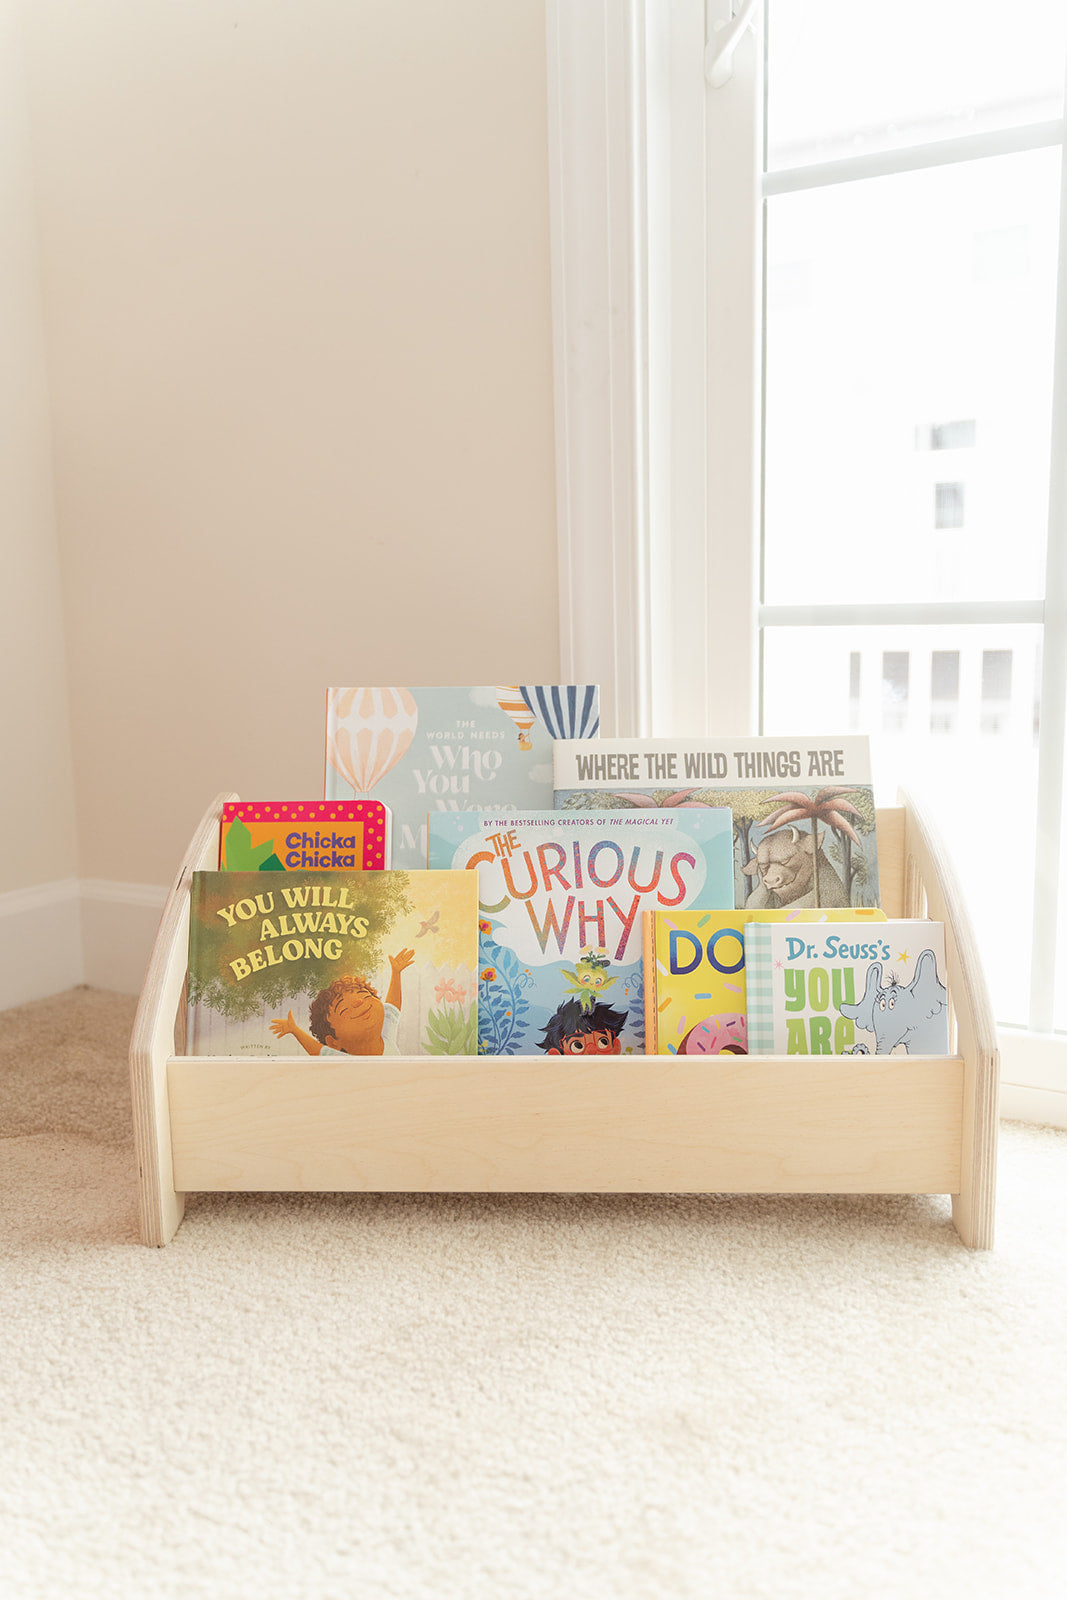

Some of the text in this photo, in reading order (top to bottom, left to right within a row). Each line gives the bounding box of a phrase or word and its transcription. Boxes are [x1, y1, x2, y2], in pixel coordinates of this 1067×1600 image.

[425, 731, 505, 740] WORLD NEEDS
[455, 719, 477, 729] THE
[428, 744, 503, 781] Who
[575, 750, 845, 781] WHERE THE WILD THINGS ARE
[412, 768, 470, 795] You
[495, 819, 507, 827] THE
[510, 818, 555, 827] BESTSELLING
[557, 818, 594, 826] CREATORS
[596, 818, 607, 826] OF
[609, 818, 623, 826] THE
[625, 818, 659, 826] MAGICAL
[661, 818, 674, 826] YET
[285, 831, 356, 849] Chicka
[485, 829, 521, 858] THE
[285, 850, 355, 868] Chicka
[465, 840, 696, 913] CURIOUS
[217, 886, 355, 928] YOU WILL
[259, 911, 370, 942] ALWAYS
[524, 894, 641, 961] WHY
[229, 938, 343, 981] BELONG
[785, 935, 891, 961] Dr. Seuss's
